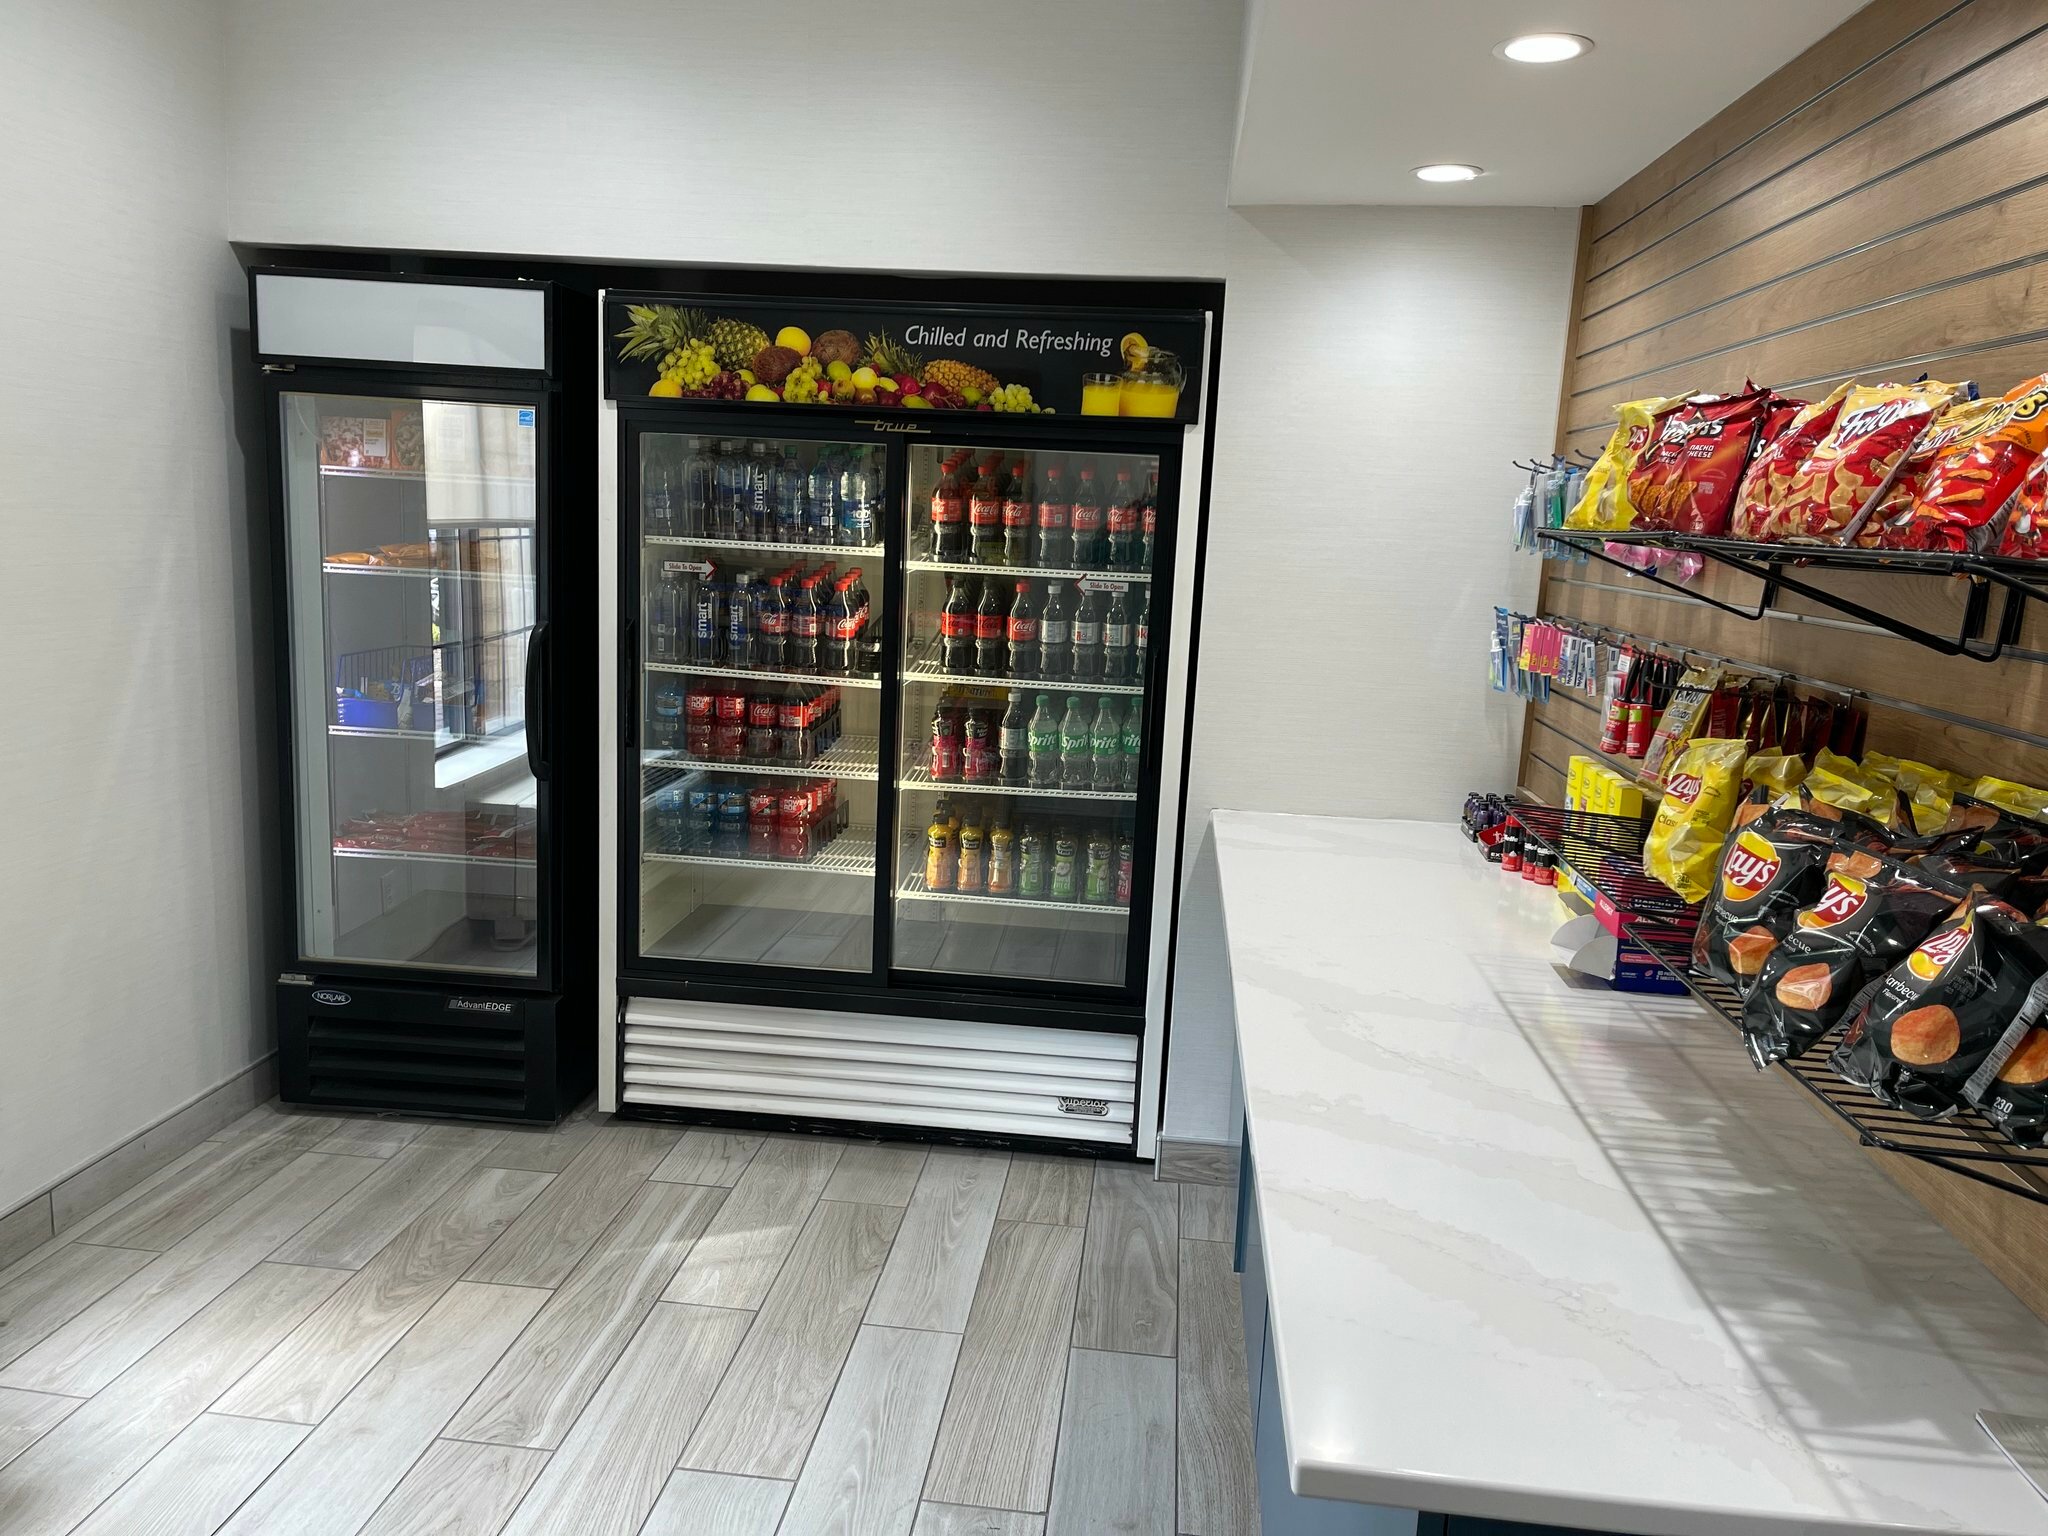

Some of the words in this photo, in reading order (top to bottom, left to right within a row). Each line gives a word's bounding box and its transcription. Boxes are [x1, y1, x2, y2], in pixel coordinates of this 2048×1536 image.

[905, 325, 967, 347] Chilled
[973, 329, 1009, 348] and
[1016, 329, 1113, 357] Refreshing
[752, 473, 764, 513] smart
[697, 602, 707, 638] smart
[730, 605, 738, 640] smart
[1813, 885, 1859, 915] y's
[1788, 934, 1812, 955] ecue
[316, 992, 347, 1003] NORLAKE
[457, 1000, 512, 1012] AdvantEDGE
[1993, 1096, 2014, 1115] 230
